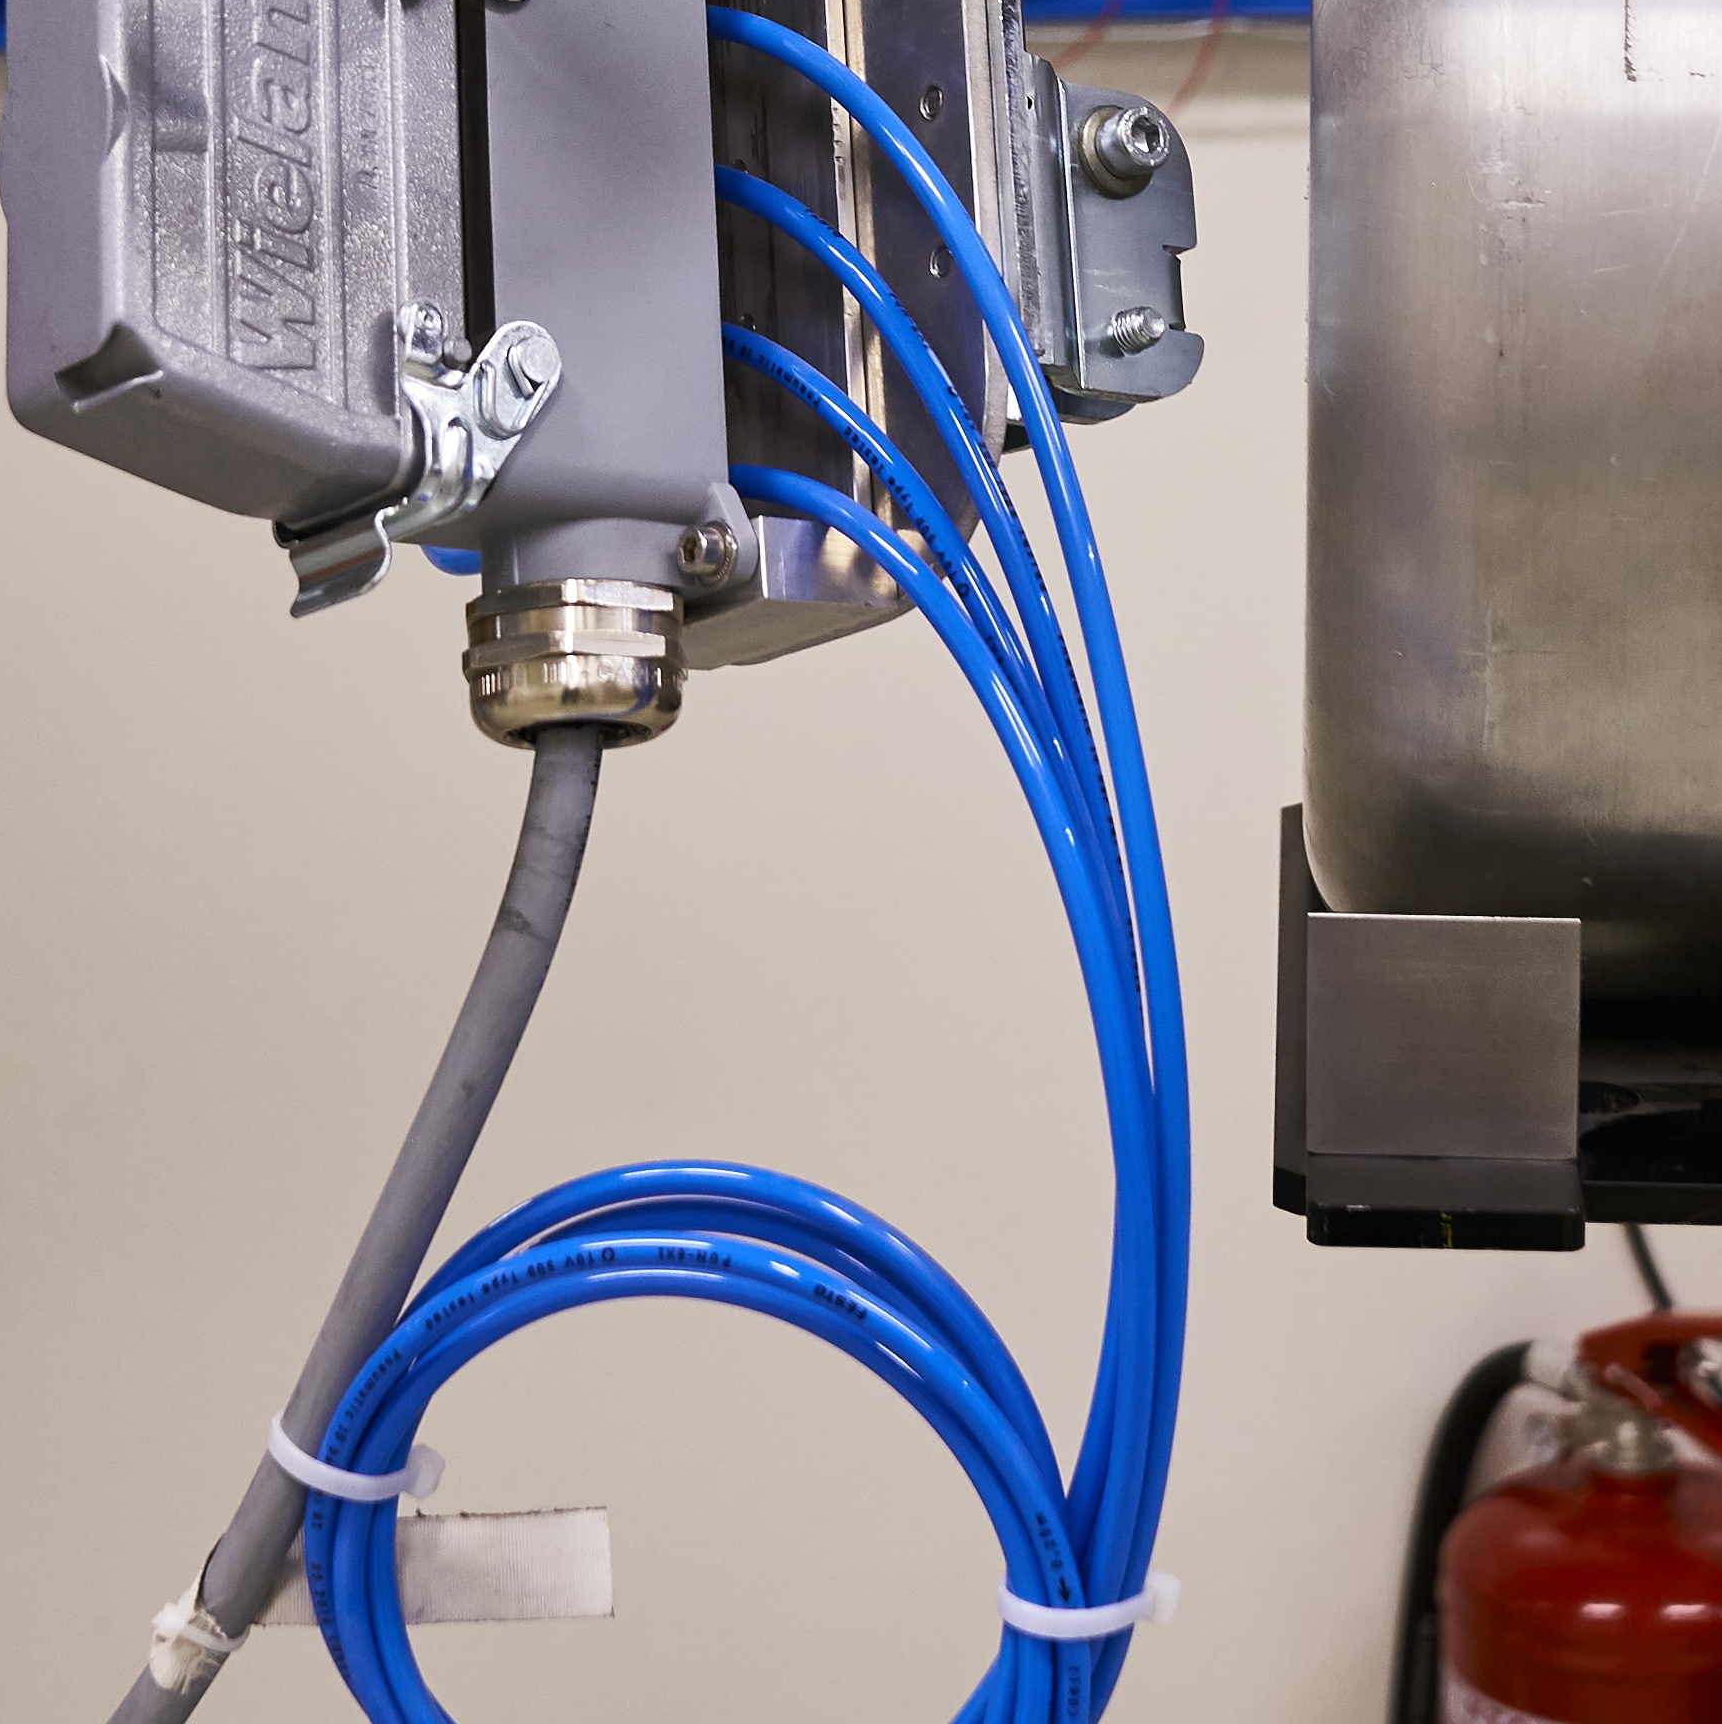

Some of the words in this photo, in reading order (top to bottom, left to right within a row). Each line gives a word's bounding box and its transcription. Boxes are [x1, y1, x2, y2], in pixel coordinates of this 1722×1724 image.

[757, 354, 821, 409] Pneumatic
[843, 425, 885, 474] tested
[887, 475, 914, 514] Type
[481, 1271, 519, 1294] Type
[813, 1282, 868, 1321] FESTO
[424, 1291, 476, 1330] tested
[344, 1348, 402, 1421] Pneumatic
